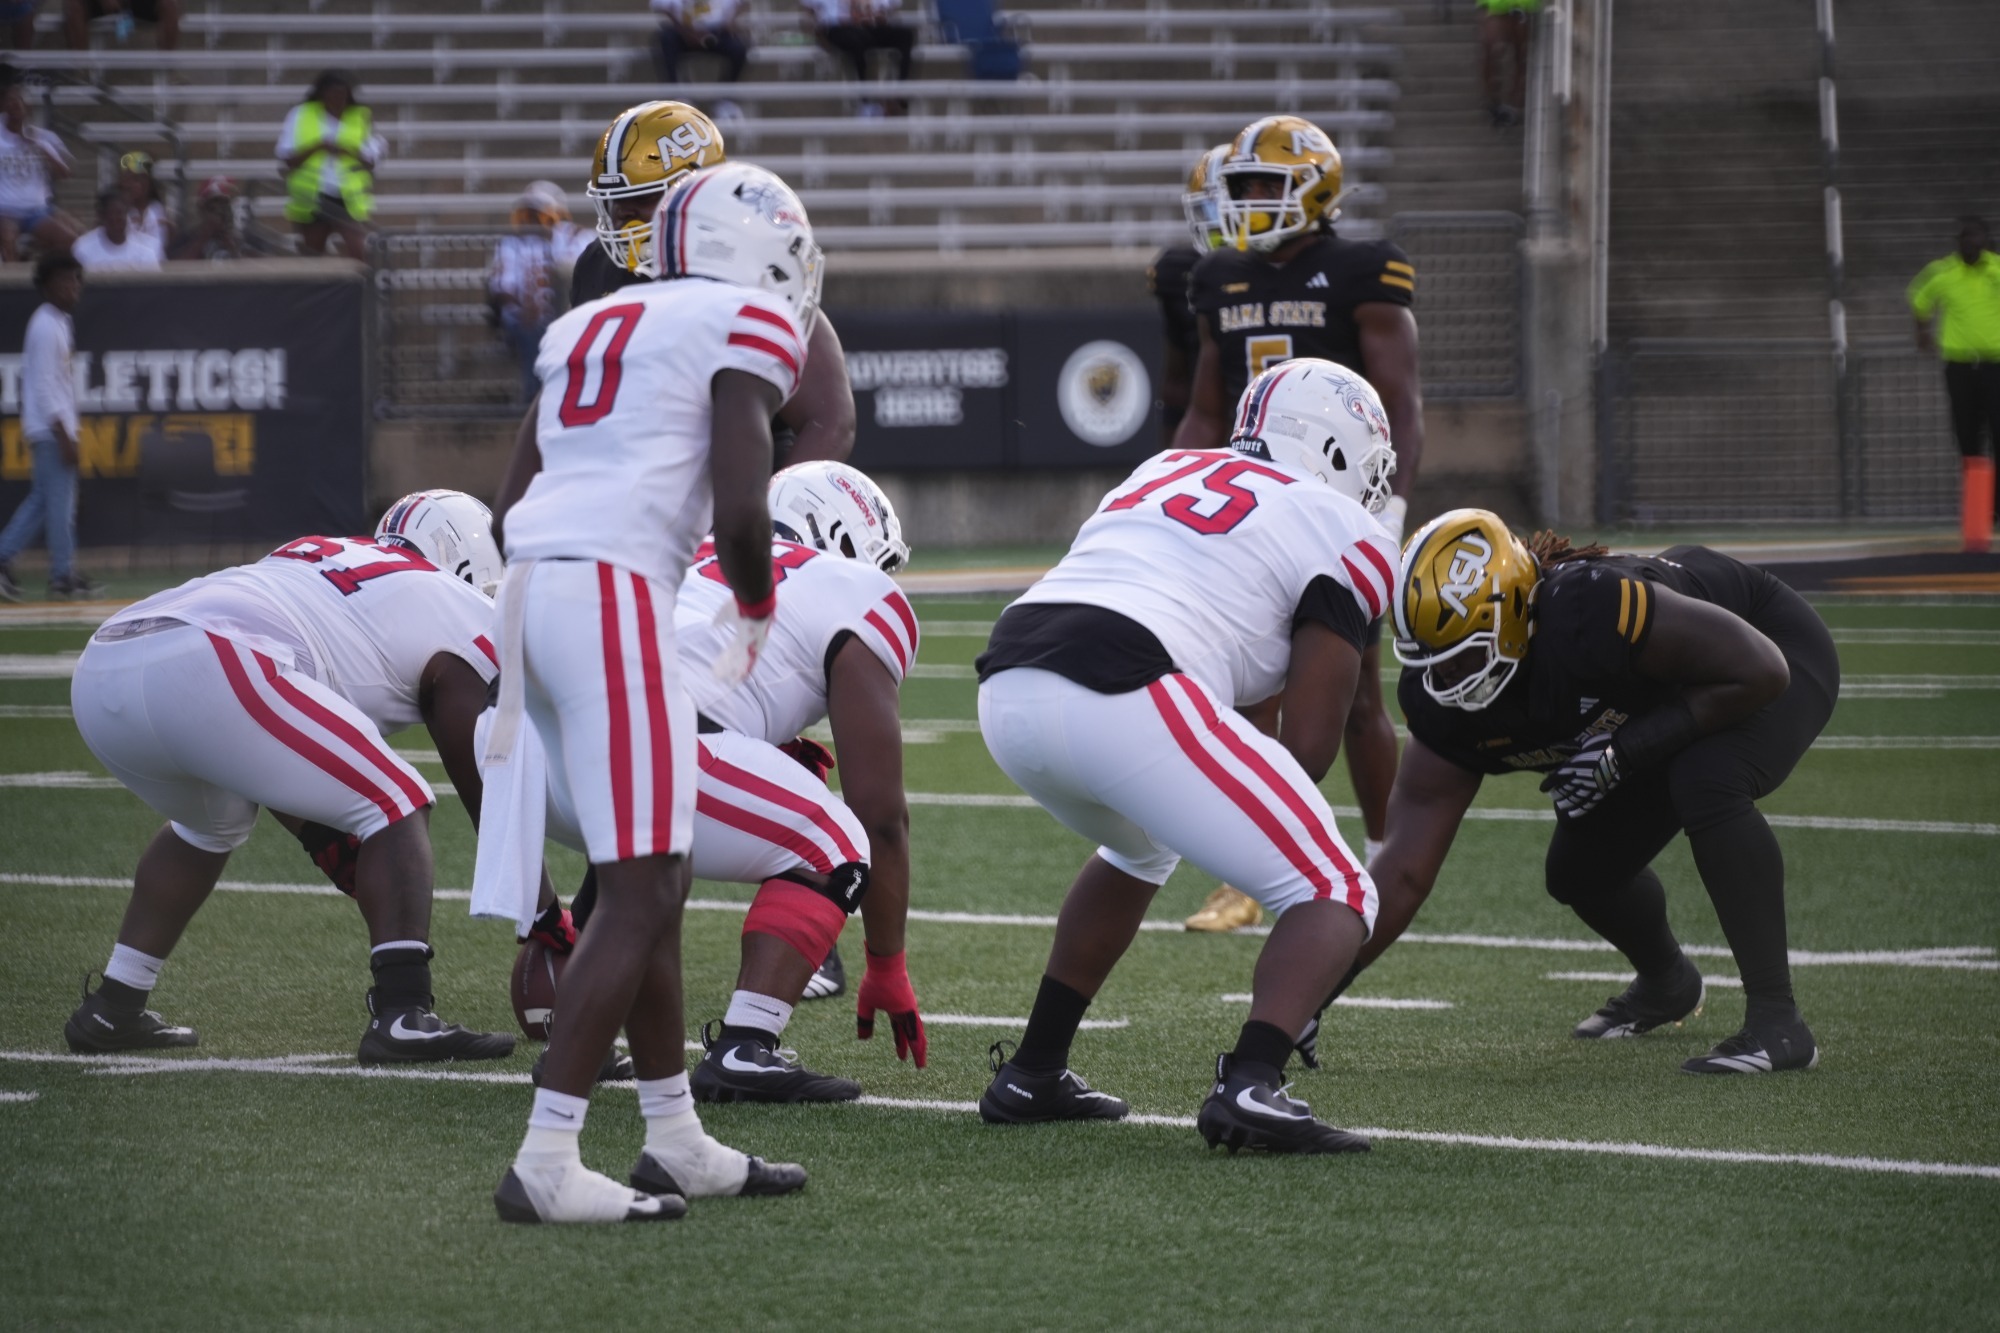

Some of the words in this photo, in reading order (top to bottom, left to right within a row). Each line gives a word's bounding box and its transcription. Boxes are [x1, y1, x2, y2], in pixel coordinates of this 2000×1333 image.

[656, 119, 713, 172] ASU
[1268, 301, 1326, 328] STATE
[558, 302, 646, 429] 0
[1102, 449, 1299, 536] 75
[1439, 533, 1493, 620] ASU
